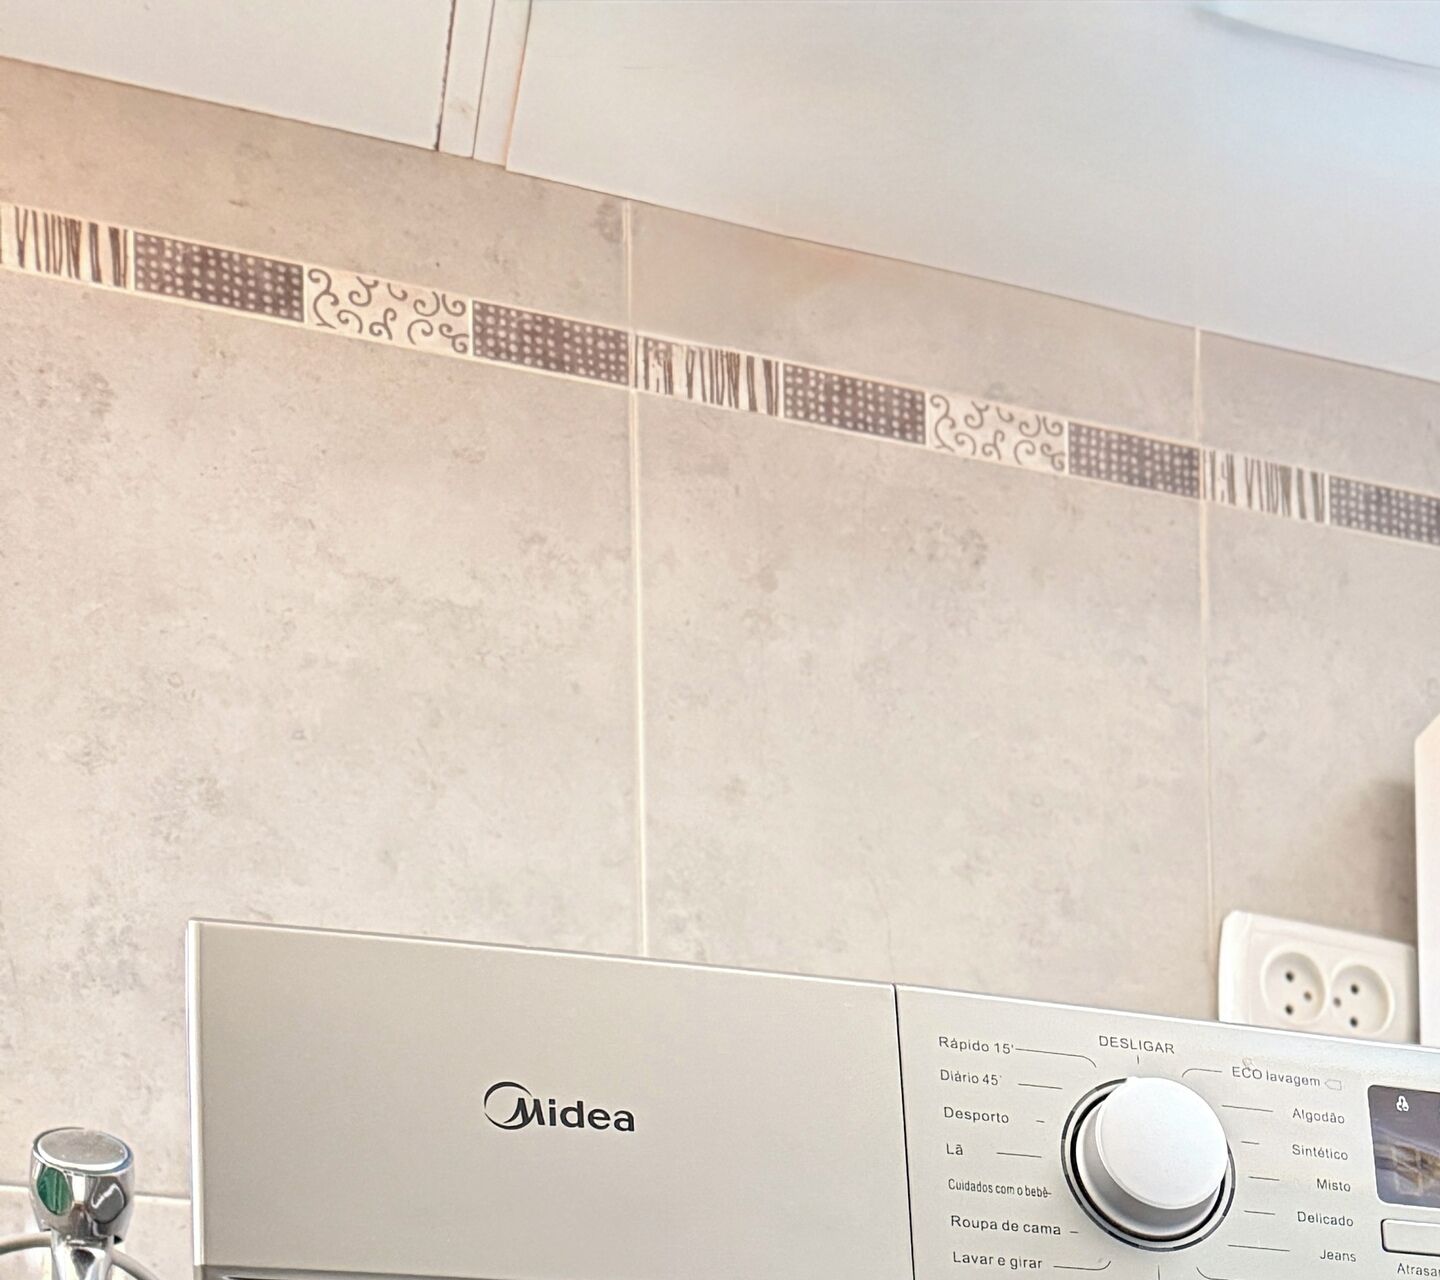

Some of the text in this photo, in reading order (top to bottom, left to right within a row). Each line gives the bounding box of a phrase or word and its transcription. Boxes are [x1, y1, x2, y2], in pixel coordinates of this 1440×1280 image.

[938, 1036, 989, 1052] Rápido
[1099, 1035, 1175, 1054] DESLIGAR
[940, 1069, 979, 1084] Diário
[1232, 1066, 1321, 1087] ECO lavagem
[483, 1081, 636, 1133] Midea
[943, 1106, 1009, 1124] Desporto
[1292, 1107, 1345, 1124] Algodão
[946, 1143, 963, 1155] Lã
[1292, 1144, 1349, 1161] Sintético
[948, 1178, 993, 1193] Cuidados
[995, 1184, 1015, 1195] com
[1017, 1187, 1023, 1196] o
[1316, 1178, 1351, 1192] Misto
[951, 1215, 1061, 1235] Roupa de cama
[1297, 1211, 1354, 1227] Delicado
[953, 1251, 1042, 1270] Lavar e girar
[1320, 1249, 1357, 1262] Jeans
